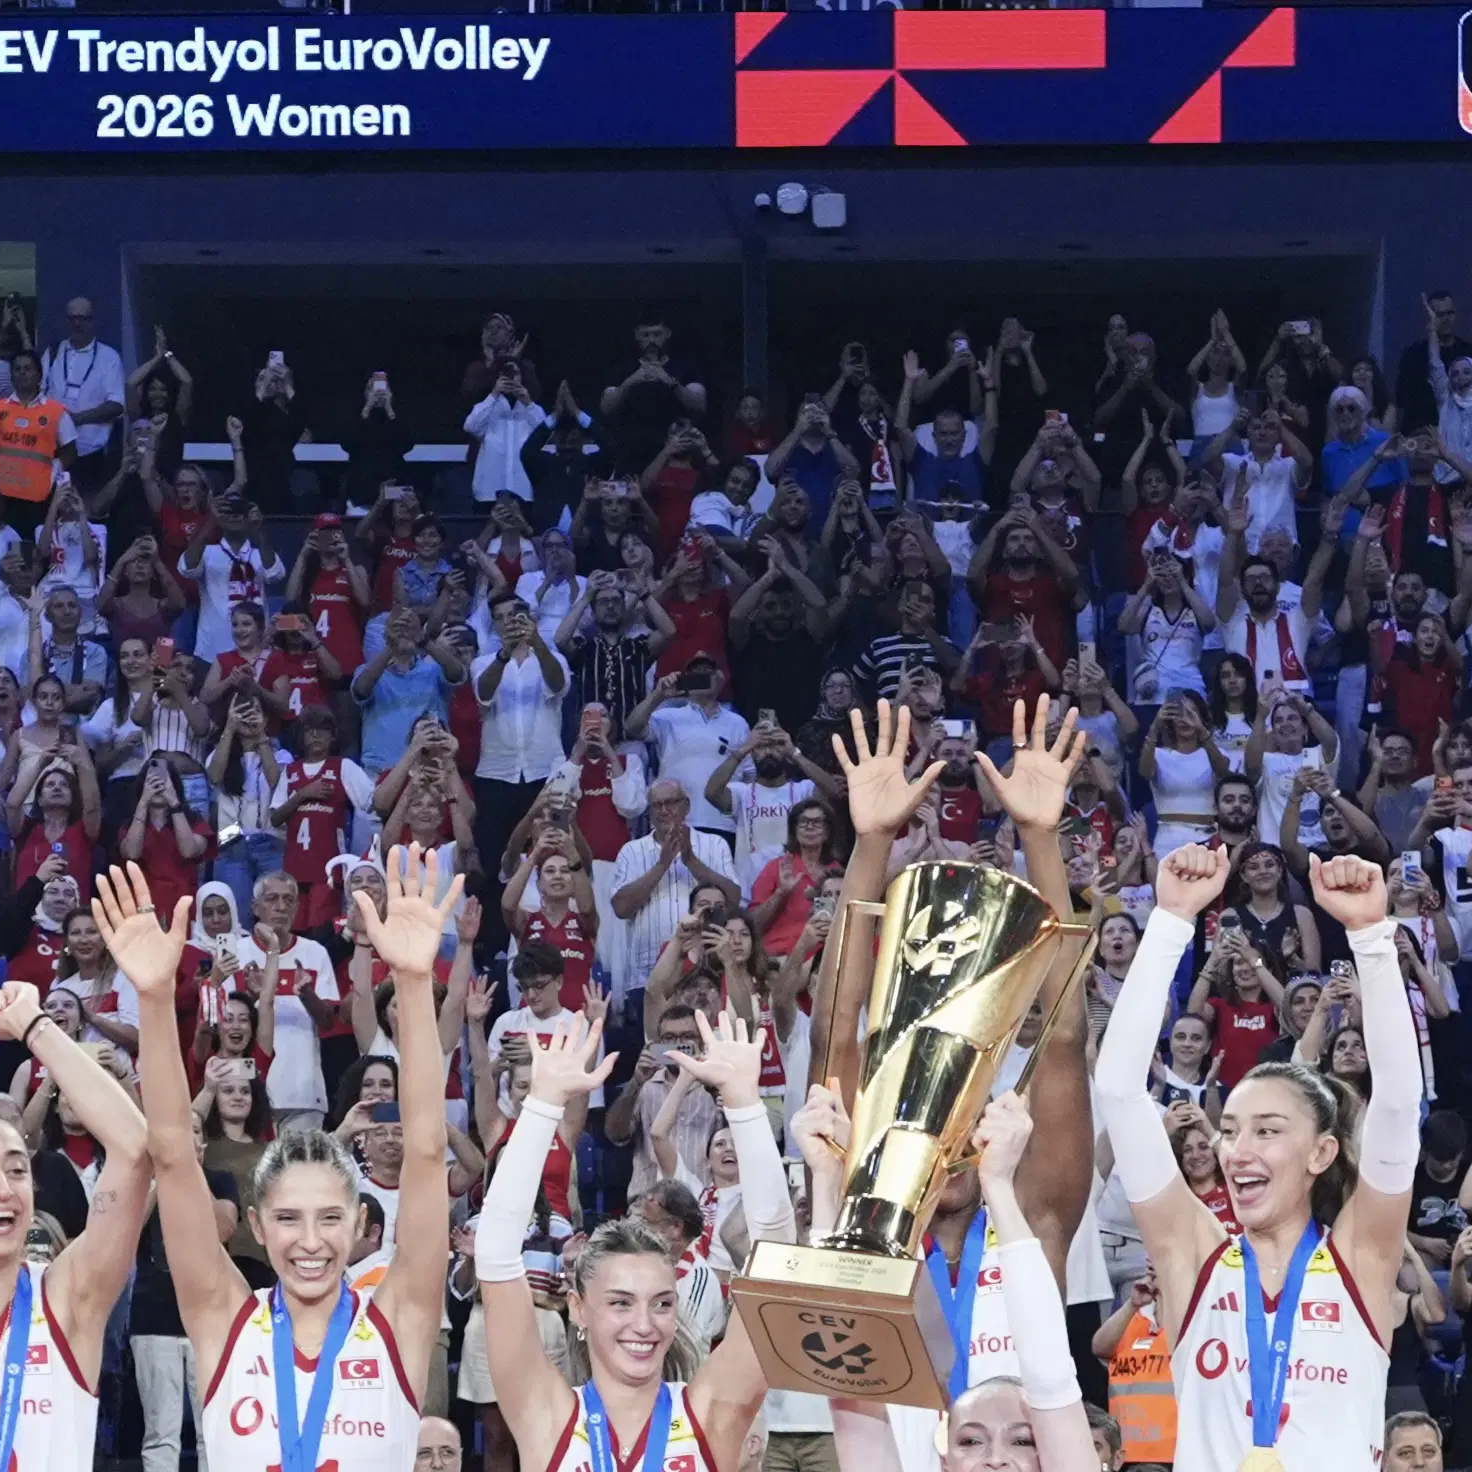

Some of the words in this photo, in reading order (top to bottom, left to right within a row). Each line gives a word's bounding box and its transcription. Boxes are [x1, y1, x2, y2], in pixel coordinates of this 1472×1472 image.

[68, 26, 280, 83] Trendyol
[296, 26, 551, 80] EuroVolley
[96, 94, 213, 139] 2026
[227, 93, 411, 138] Women
[316, 609, 330, 638] 4
[289, 687, 303, 716] 4
[297, 817, 310, 850] 4
[798, 1311, 856, 1330] CEV
[350, 1379, 374, 1387] TUR
